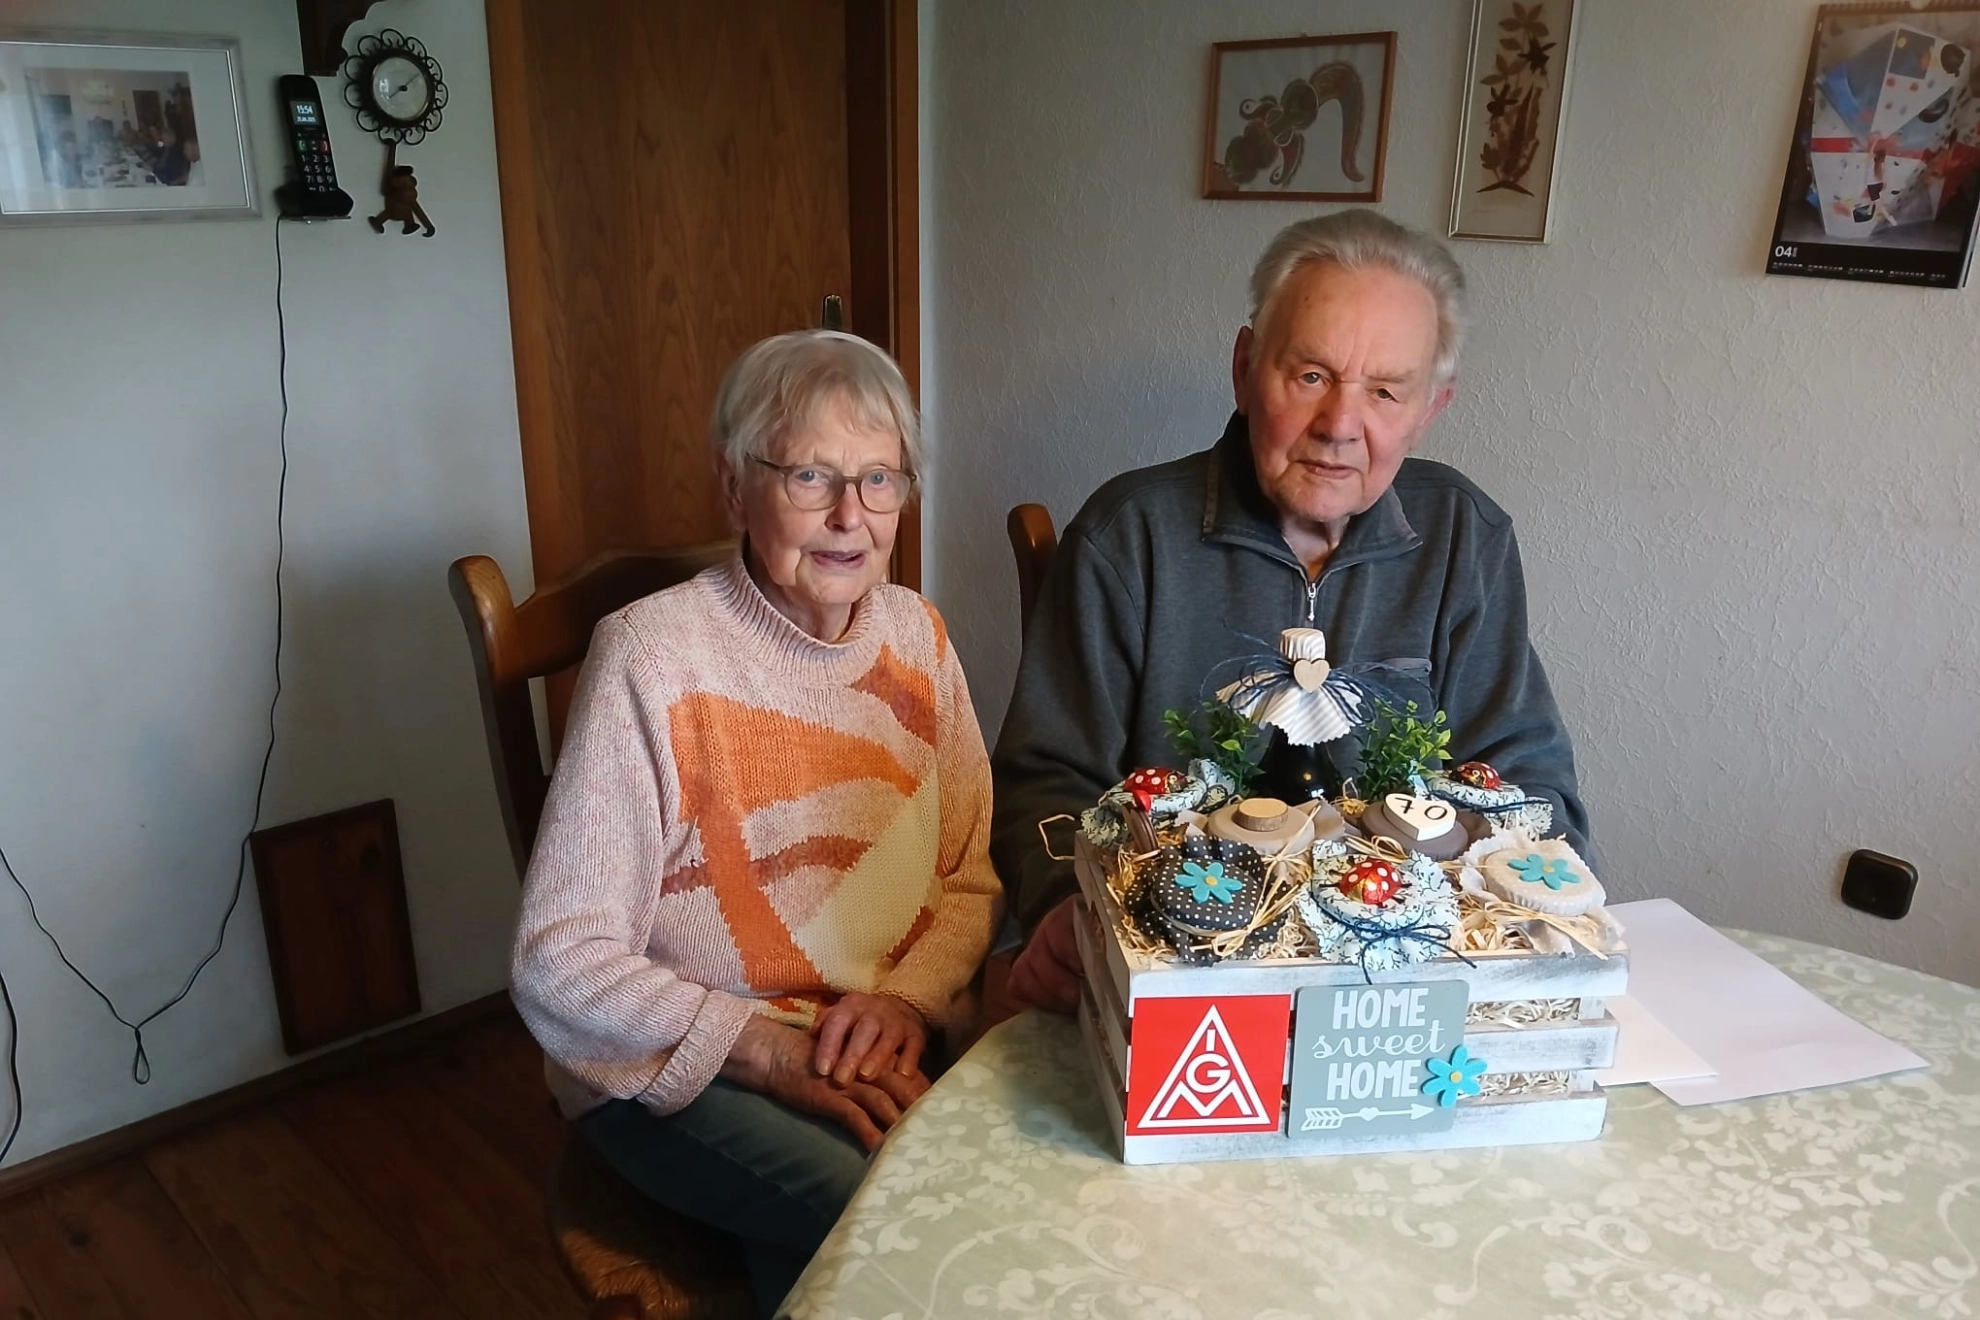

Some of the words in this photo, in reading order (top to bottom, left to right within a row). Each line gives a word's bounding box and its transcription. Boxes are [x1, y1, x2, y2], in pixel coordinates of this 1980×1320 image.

[1774, 245, 1792, 258] 04
[1394, 797, 1448, 821] 70
[1332, 987, 1430, 1030] HOME
[1312, 1018, 1446, 1059] sweet
[1326, 1059, 1422, 1101] HOME
